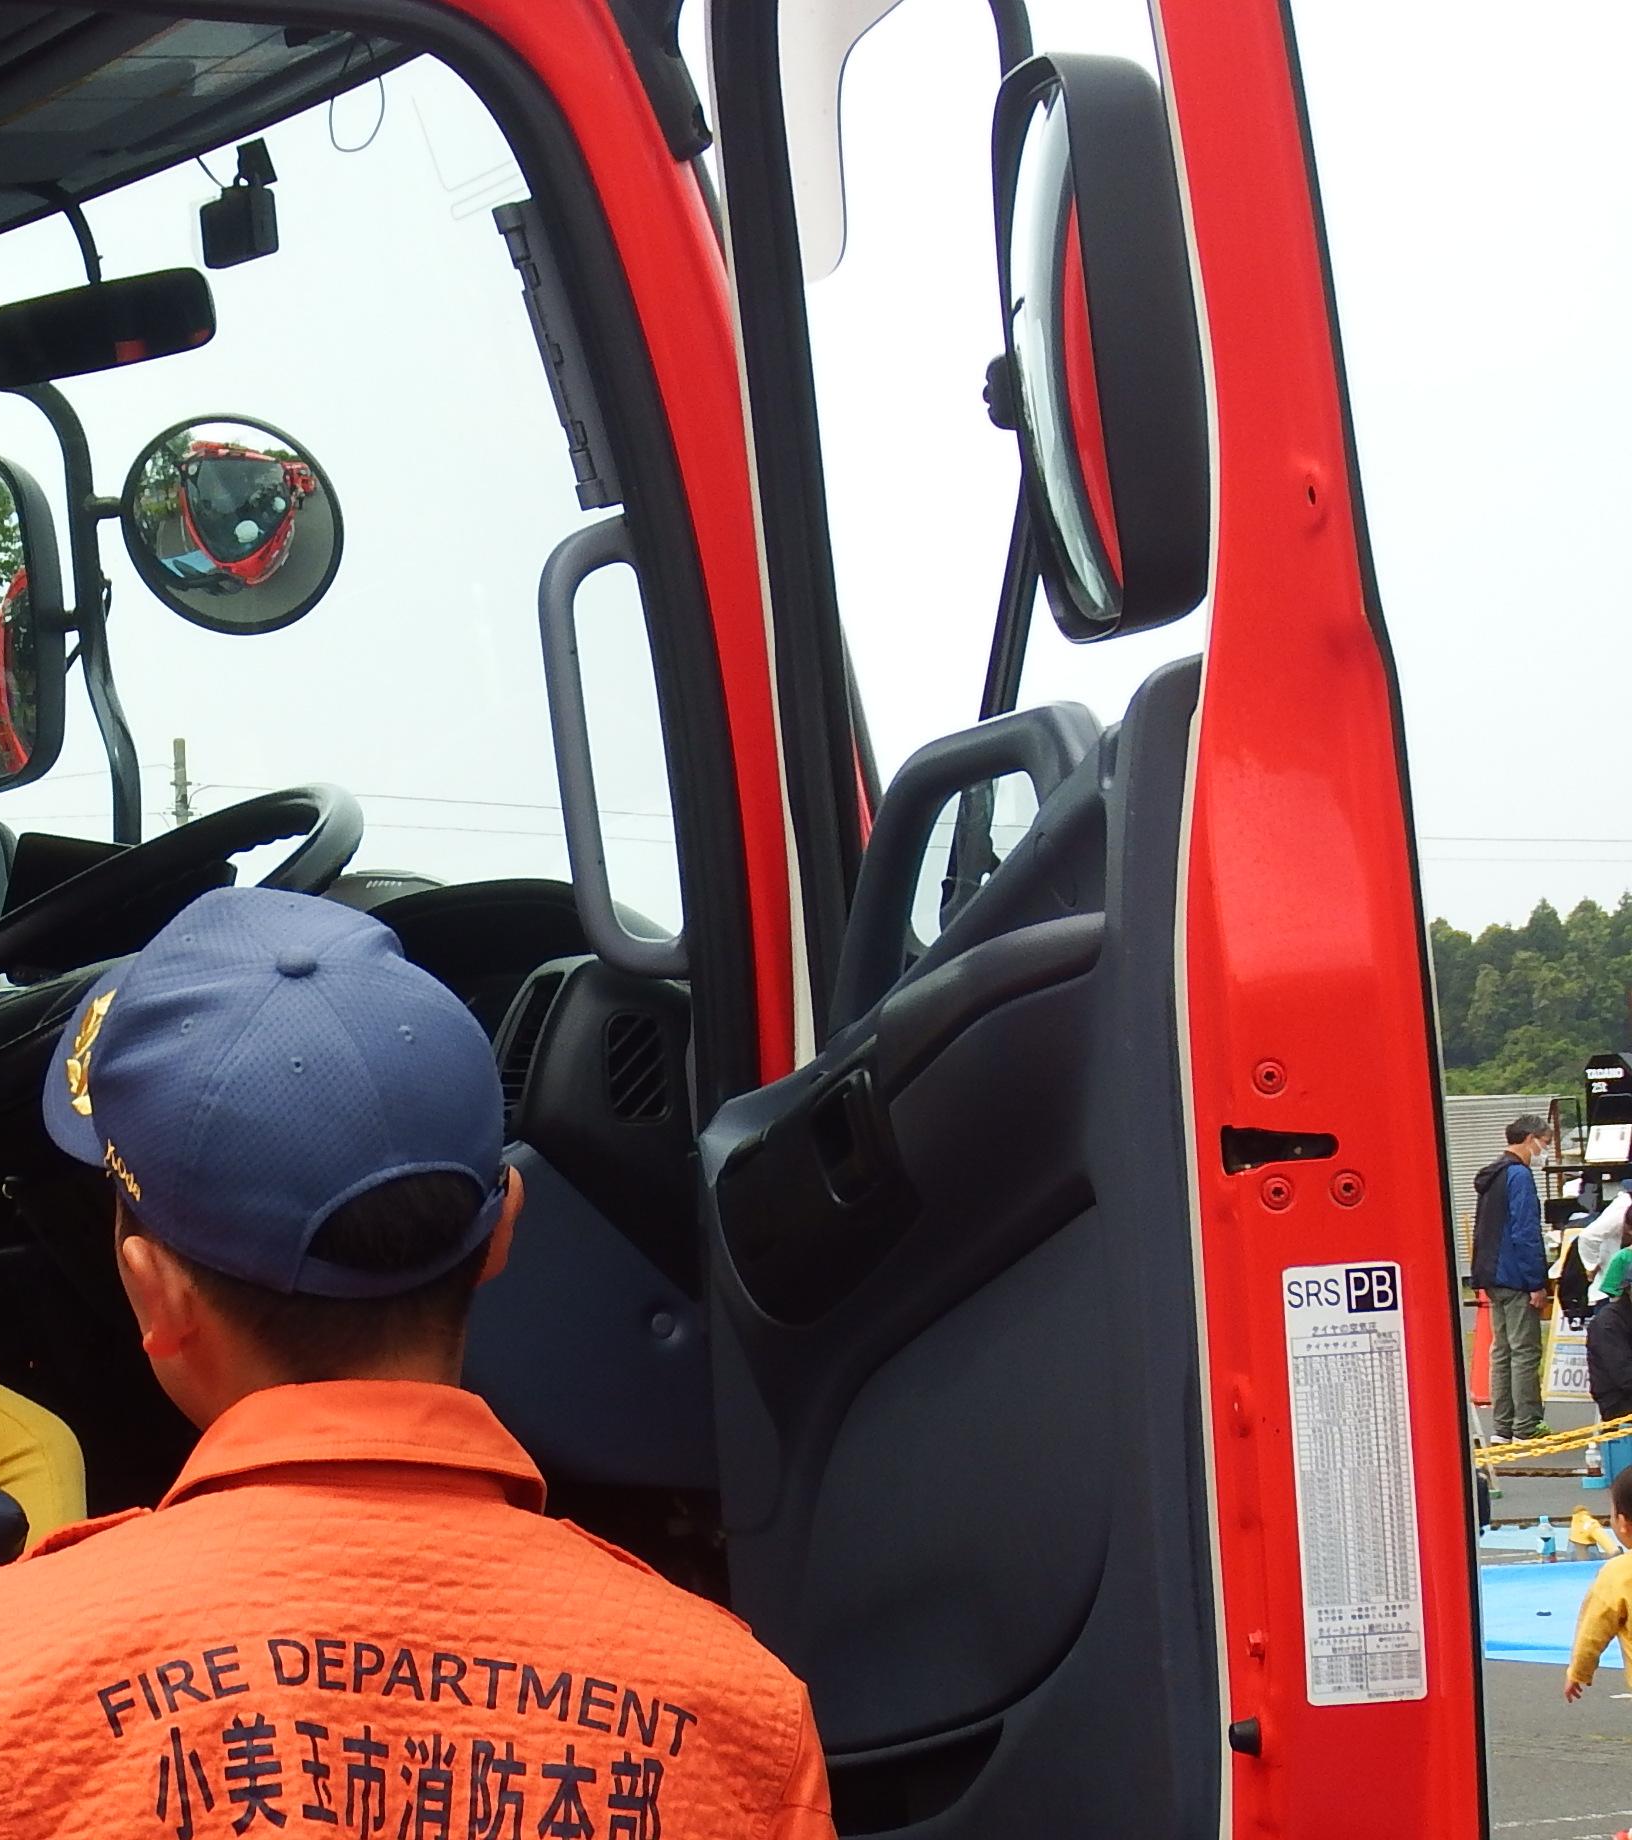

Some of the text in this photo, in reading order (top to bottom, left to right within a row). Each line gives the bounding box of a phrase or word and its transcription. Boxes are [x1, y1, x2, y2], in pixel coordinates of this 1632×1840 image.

[1287, 1270, 1394, 1310] SRS PB
[97, 1638, 698, 1759] FIRE DEPARTMENT
[155, 1711, 665, 1840] 小美玉市消防本部
